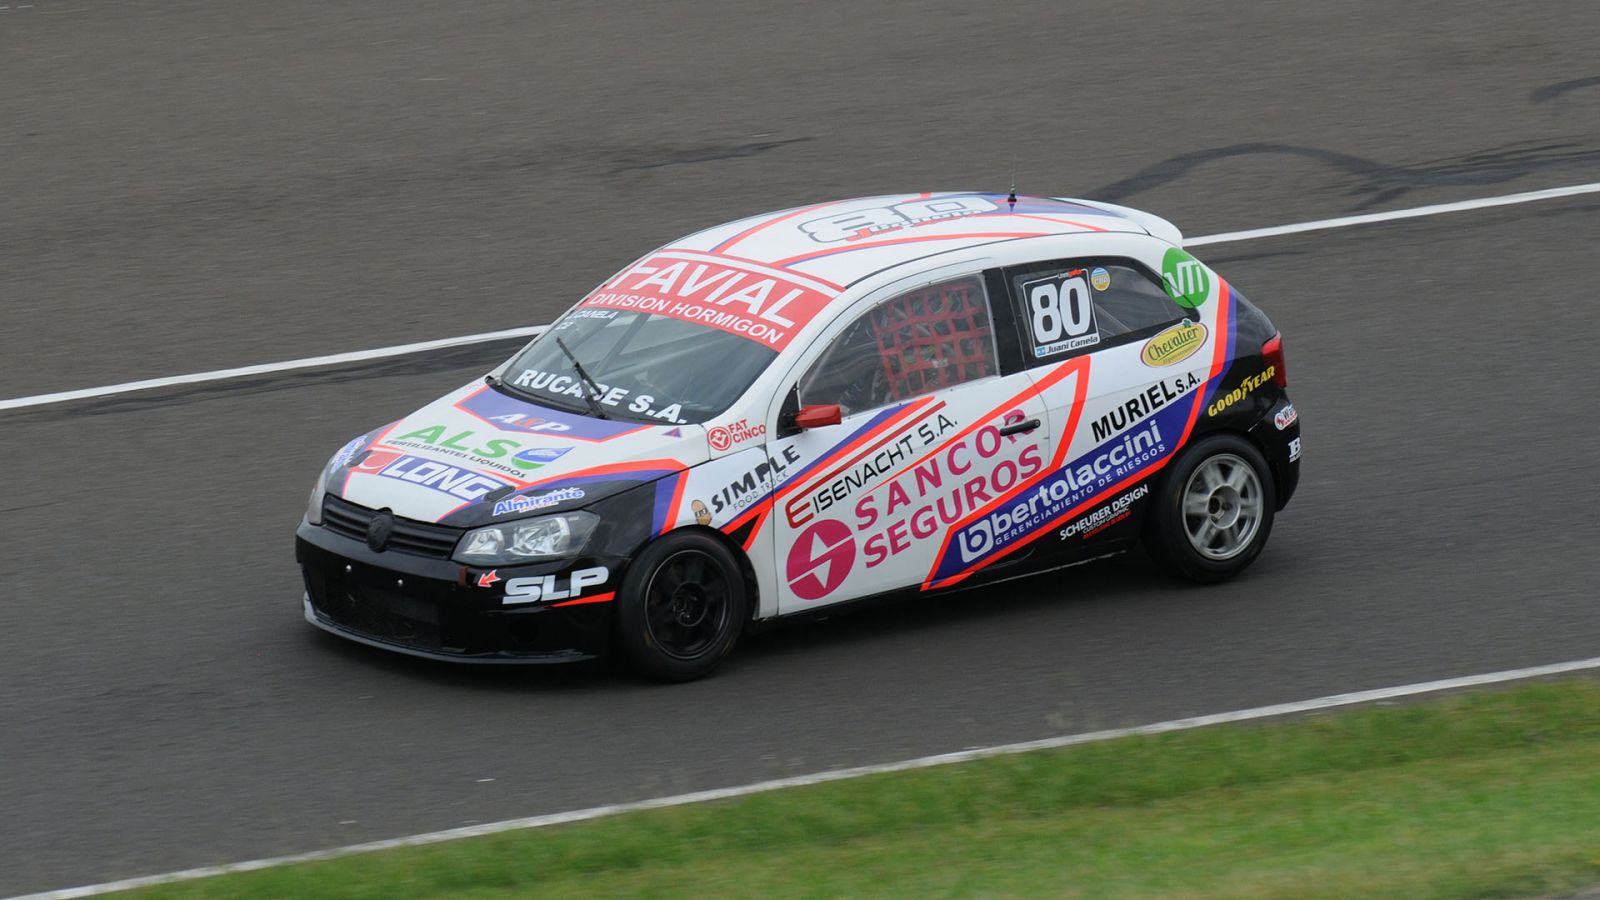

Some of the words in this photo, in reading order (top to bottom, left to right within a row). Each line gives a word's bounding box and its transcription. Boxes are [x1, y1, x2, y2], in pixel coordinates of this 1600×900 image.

[797, 197, 1000, 243] 80
[606, 258, 804, 328] FAVIAL
[1031, 276, 1092, 344] 80
[589, 293, 672, 312] DIVISION
[670, 302, 785, 344] HORMIGON
[1047, 341, 1069, 354] Juani
[1070, 335, 1098, 348] Canela
[1147, 327, 1199, 361] Chevalier
[628, 395, 688, 425] S.A.
[728, 419, 748, 434] FAT
[1090, 380, 1177, 443] MURIEL
[1175, 371, 1202, 396] S.A.
[396, 425, 522, 459] ALS
[732, 424, 767, 443] CINCO
[382, 456, 505, 501] LONG
[384, 438, 467, 460] FERTILIZANTES
[468, 455, 527, 479] LIQUIDOS
[711, 444, 801, 514] SIMPLE
[785, 433, 914, 529] EISENACHT
[917, 413, 958, 446] S.A.
[854, 408, 1035, 531] SANCOR
[993, 419, 1163, 538] bertolaccini
[494, 489, 585, 515] Almirante
[733, 490, 759, 511] FOOD
[760, 470, 789, 491] TRUCK
[863, 443, 1042, 569] SEGUROS
[995, 486, 1094, 546] GERENCIAMIENTO
[1098, 474, 1113, 488] DE
[1117, 443, 1166, 477] RIESGOS
[1059, 505, 1112, 541] SCHEURER
[1111, 483, 1149, 512] DESIGN
[502, 566, 609, 605] SLP
